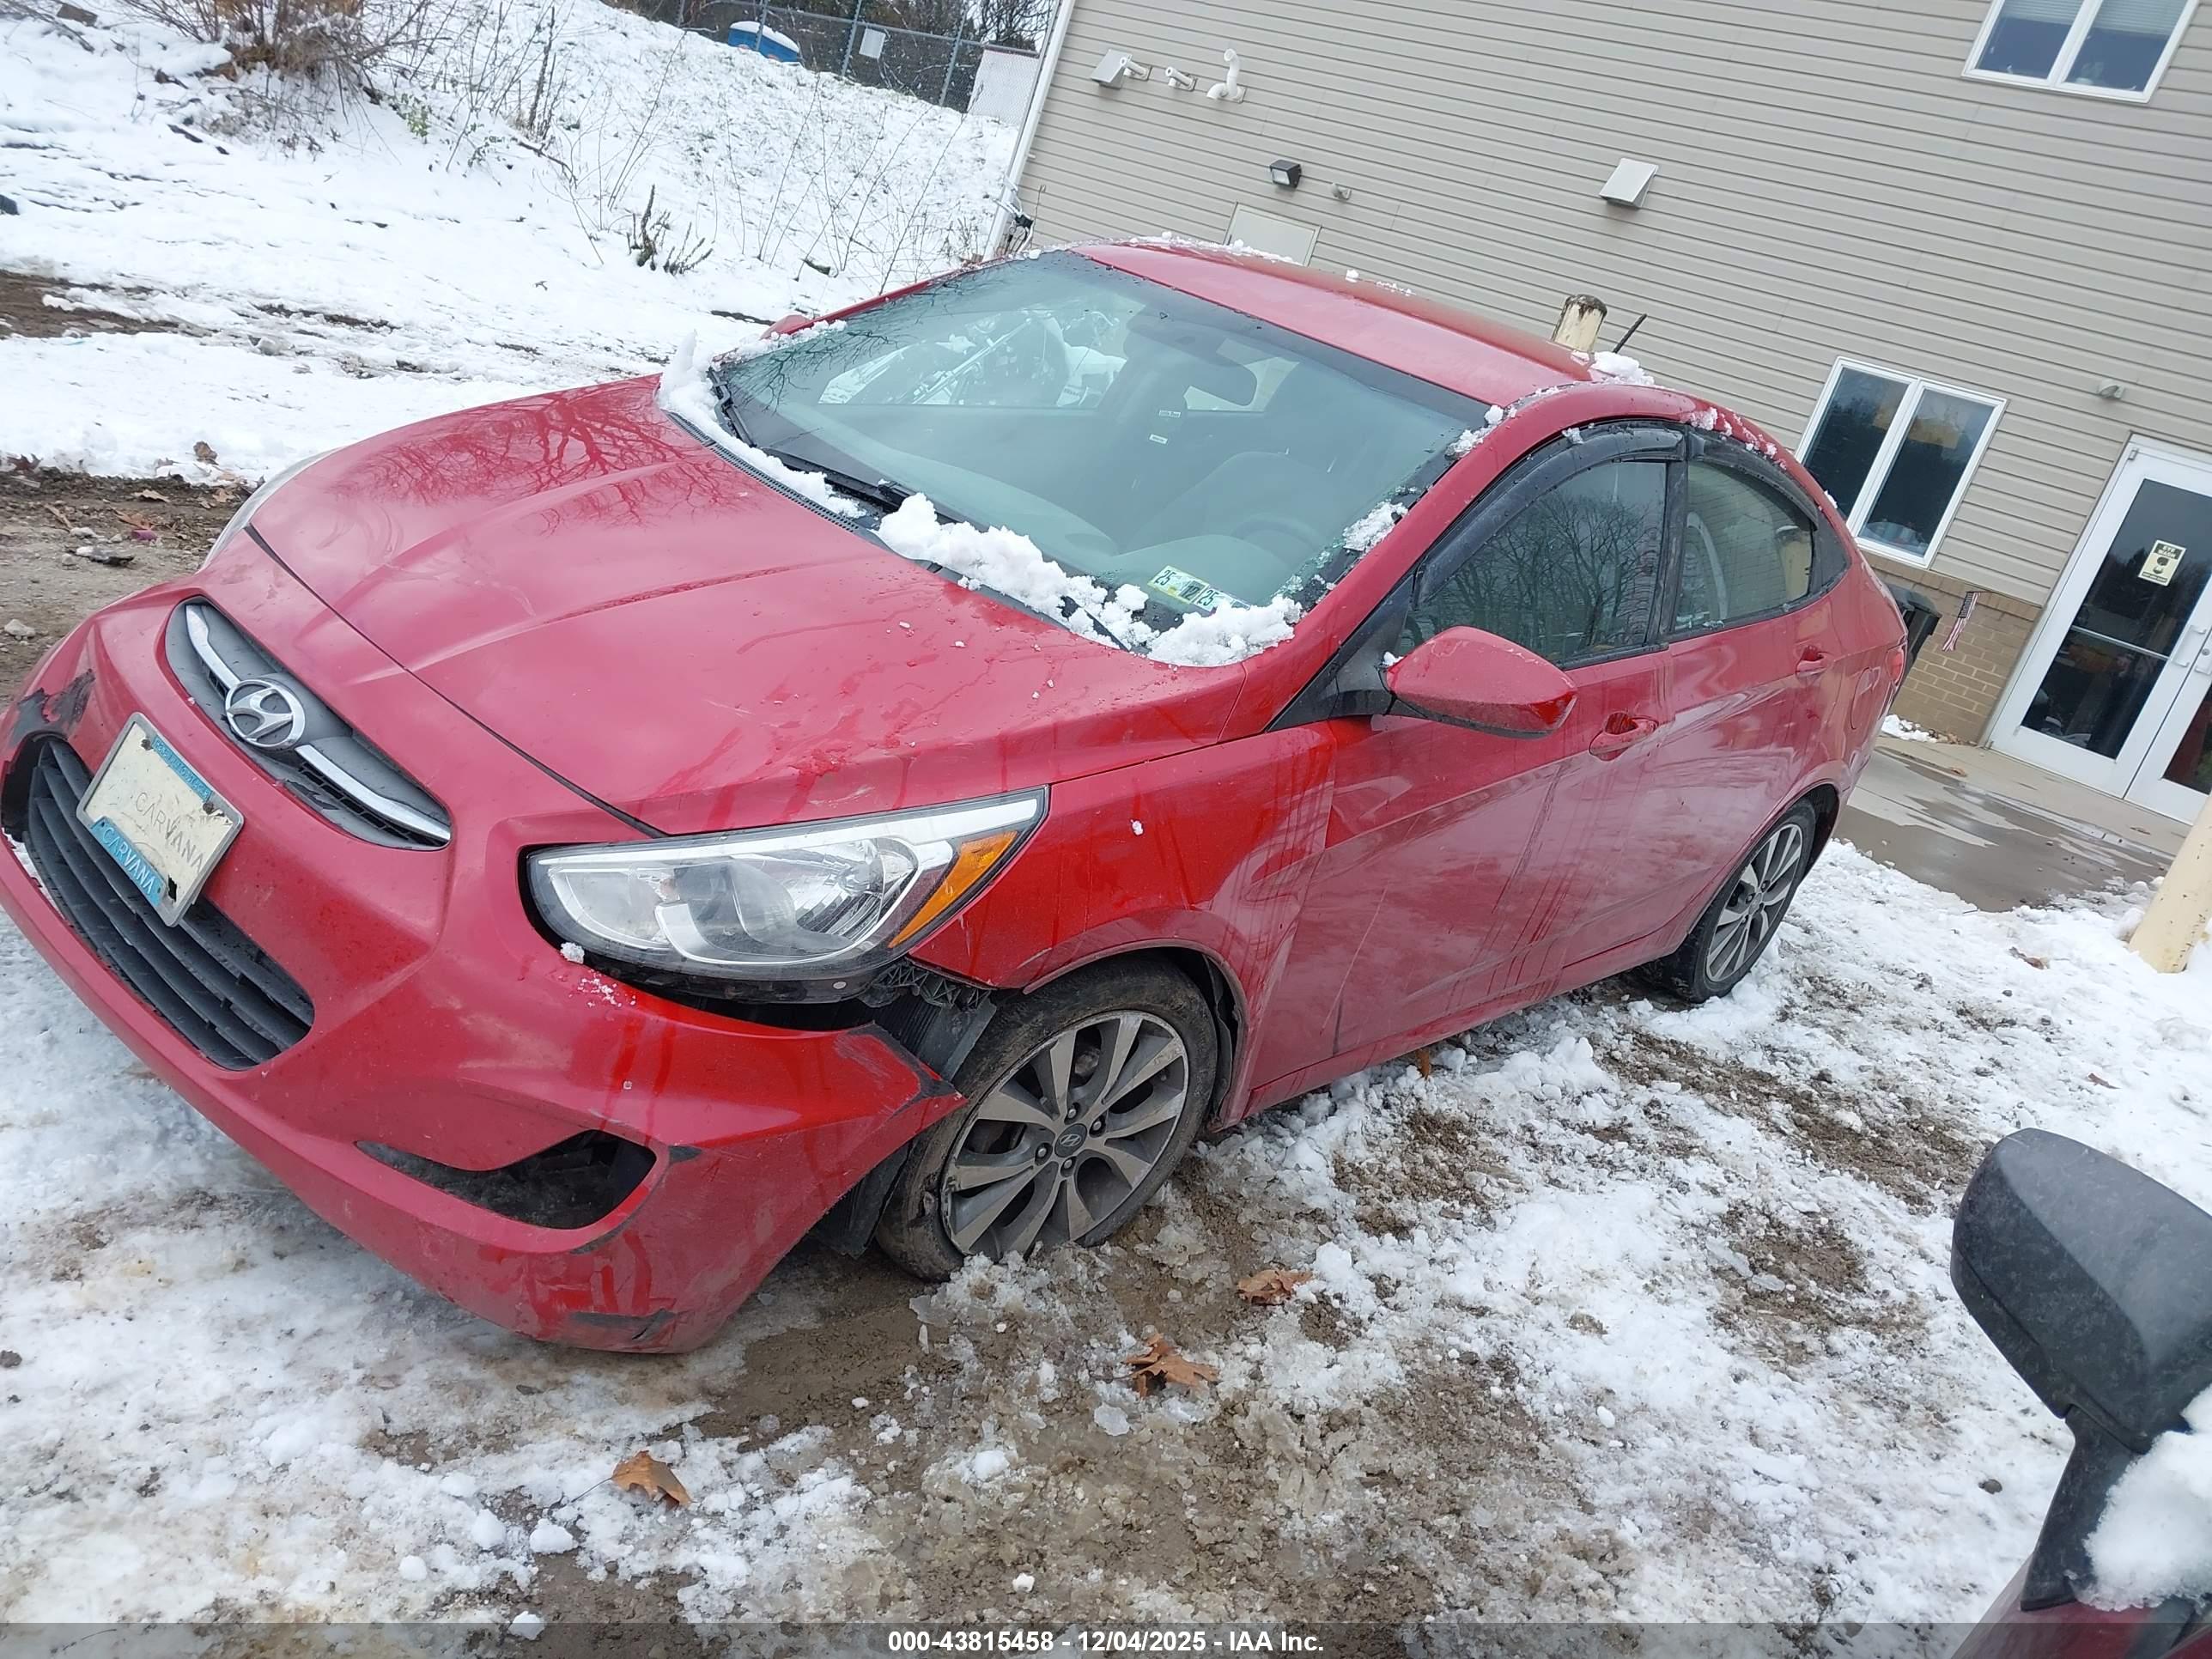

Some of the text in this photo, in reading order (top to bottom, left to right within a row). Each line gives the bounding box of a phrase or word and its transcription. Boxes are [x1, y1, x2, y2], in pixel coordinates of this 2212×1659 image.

[1155, 569, 1176, 586] 25
[1181, 584, 1200, 600] 12
[1198, 589, 1219, 606] 25
[135, 792, 204, 873] CARVANA
[100, 825, 154, 895] CARVANA
